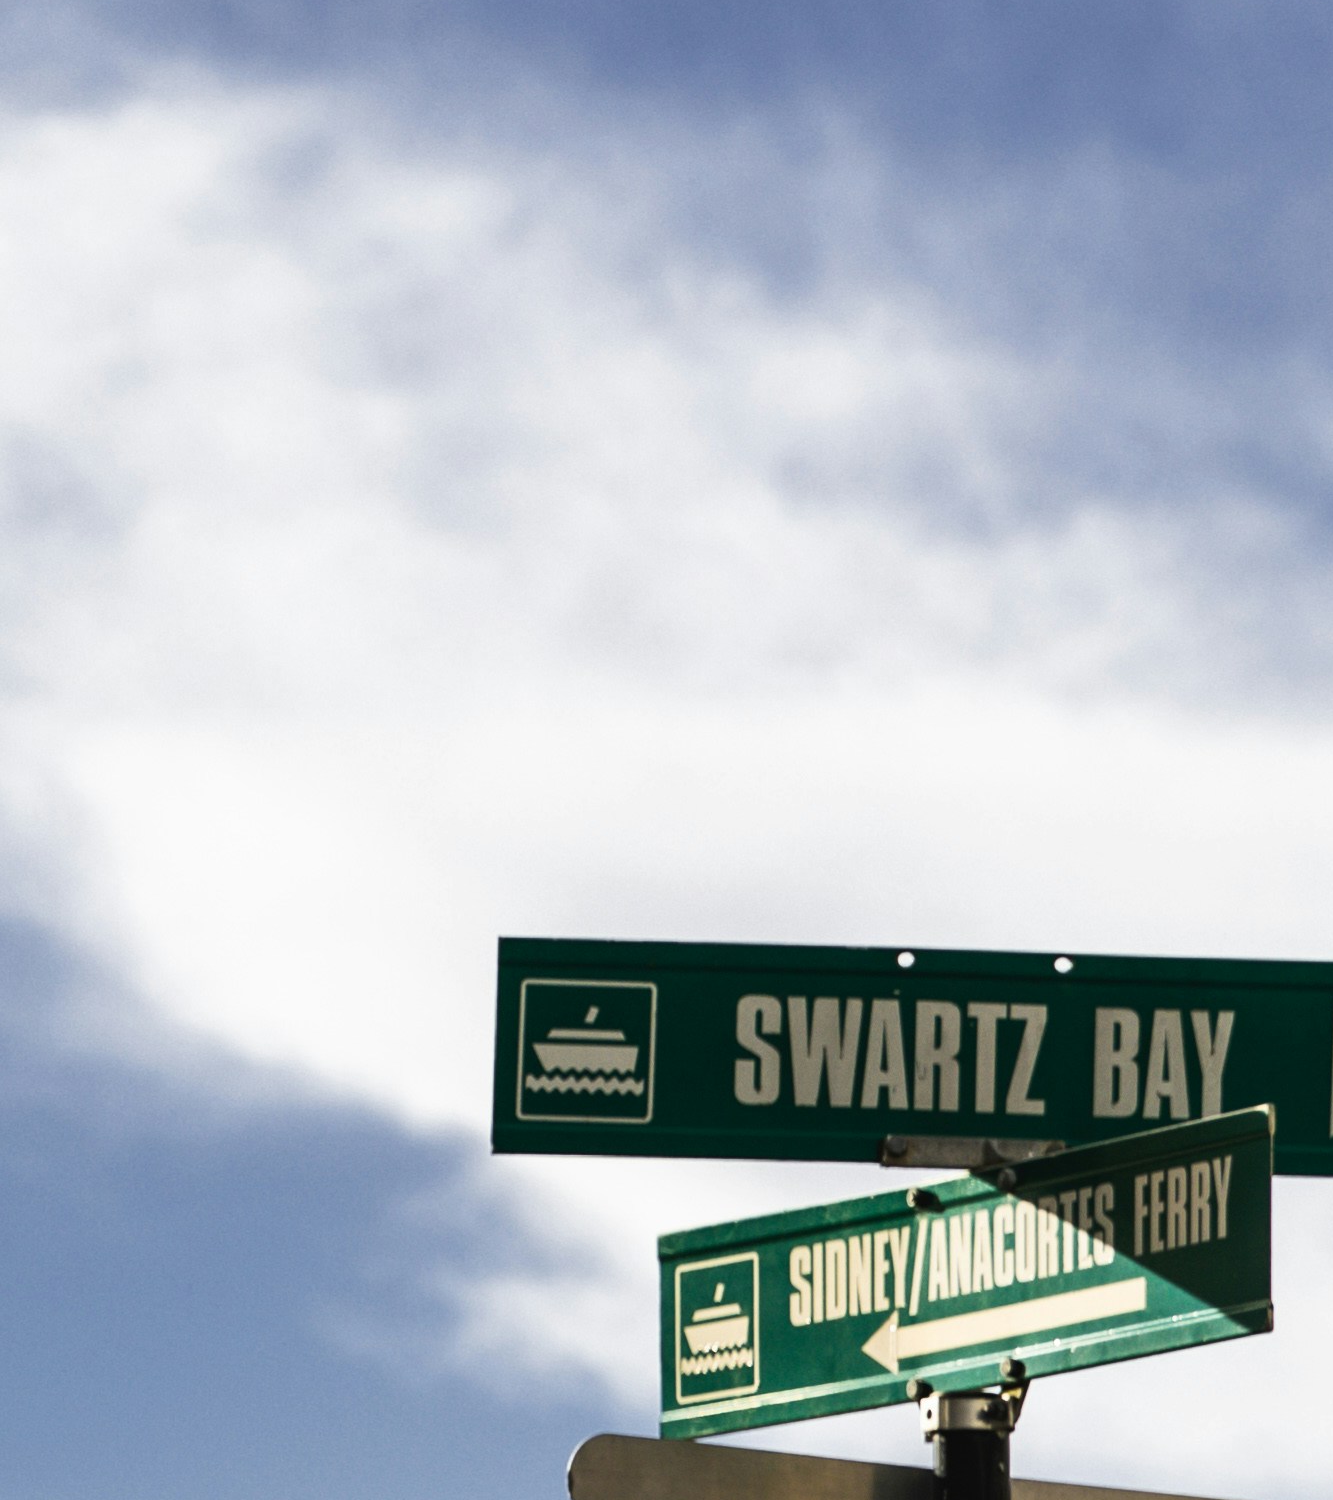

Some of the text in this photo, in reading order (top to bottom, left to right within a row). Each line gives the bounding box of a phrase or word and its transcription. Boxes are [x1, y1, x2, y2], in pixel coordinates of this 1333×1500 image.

[734, 994, 1236, 1120] SWARTZ BAY
[788, 1154, 1235, 1329] SIDNEY/ANACORTES FERRY
